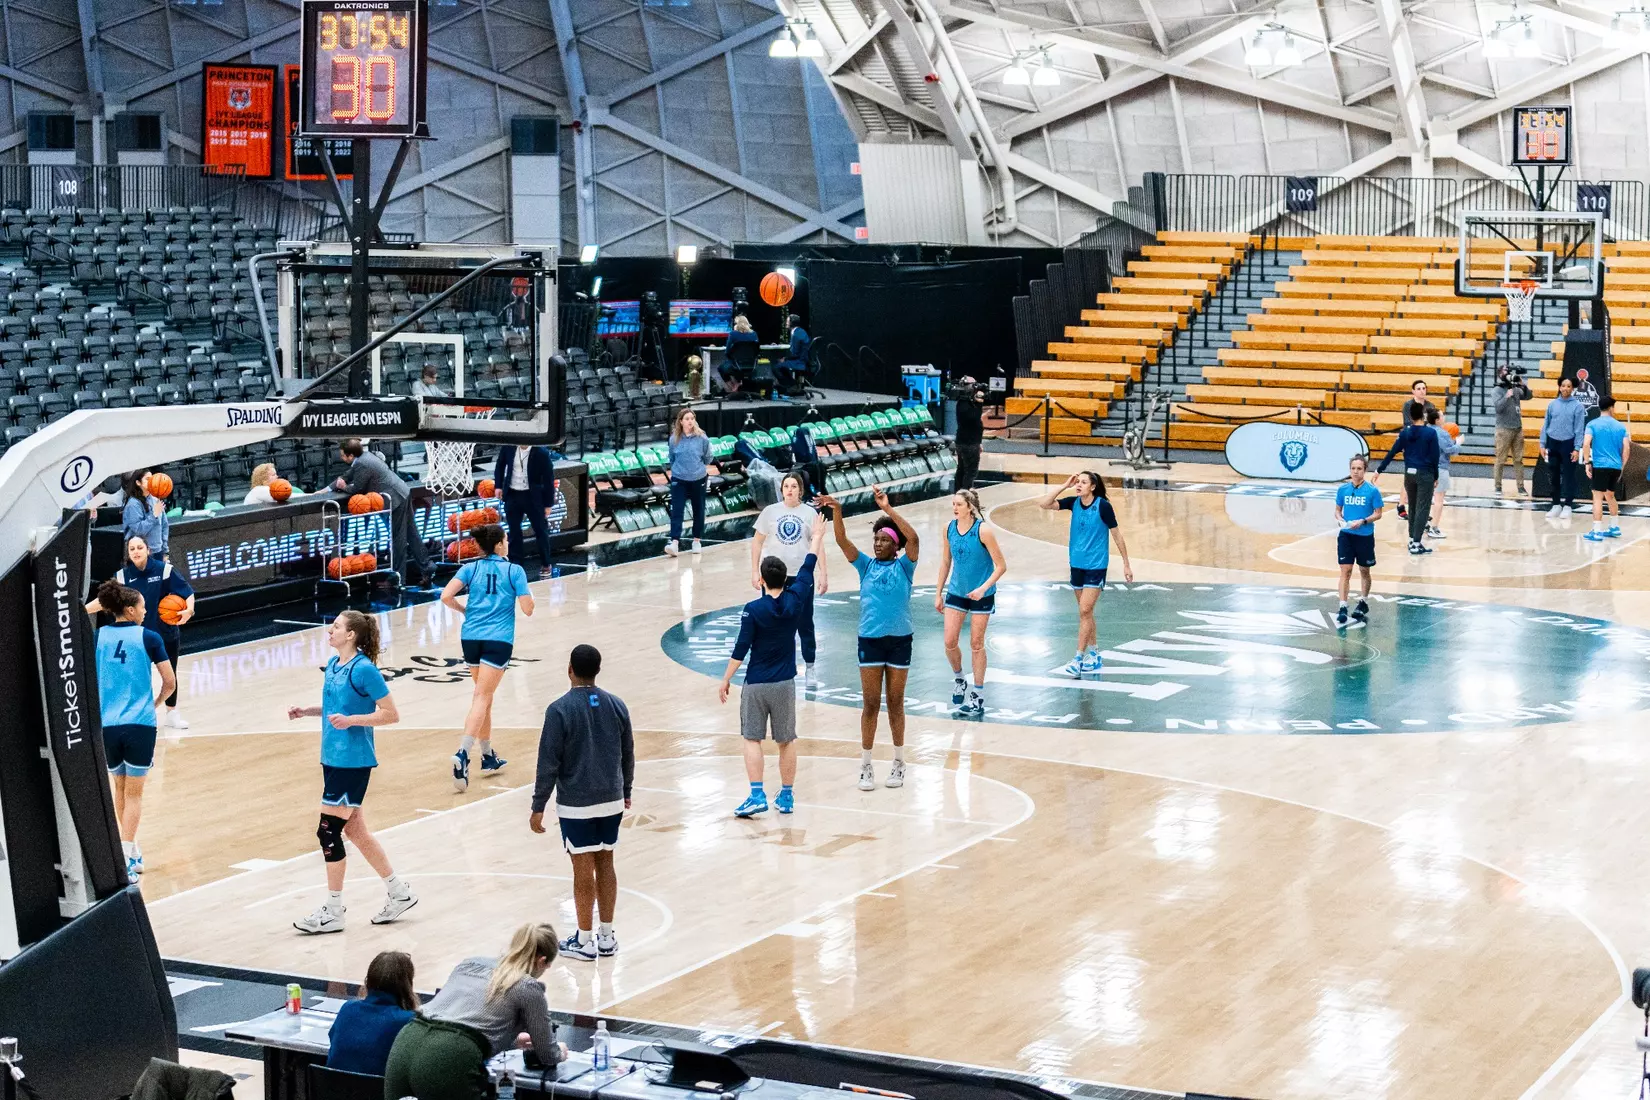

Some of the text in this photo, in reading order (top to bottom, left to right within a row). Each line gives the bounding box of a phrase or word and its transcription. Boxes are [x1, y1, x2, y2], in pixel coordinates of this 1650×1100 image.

[320, 15, 409, 50] 37:54
[209, 71, 271, 81] PRINCETON
[331, 56, 396, 118] 30
[208, 119, 270, 129] CHAMPIONS
[59, 180, 77, 194] 108
[1291, 189, 1314, 201] 109
[1582, 196, 1607, 210] 110
[227, 405, 282, 427] SPALDING
[302, 411, 402, 428] IVY LEAGUE ON ESPN
[1271, 428, 1320, 444] COLUMBIA
[1344, 496, 1366, 506] EDGE
[186, 529, 303, 580] WELCOME
[304, 527, 335, 557] TO
[485, 573, 498, 595] 11
[53, 556, 82, 750] TicketSmarter
[113, 640, 127, 664] 4
